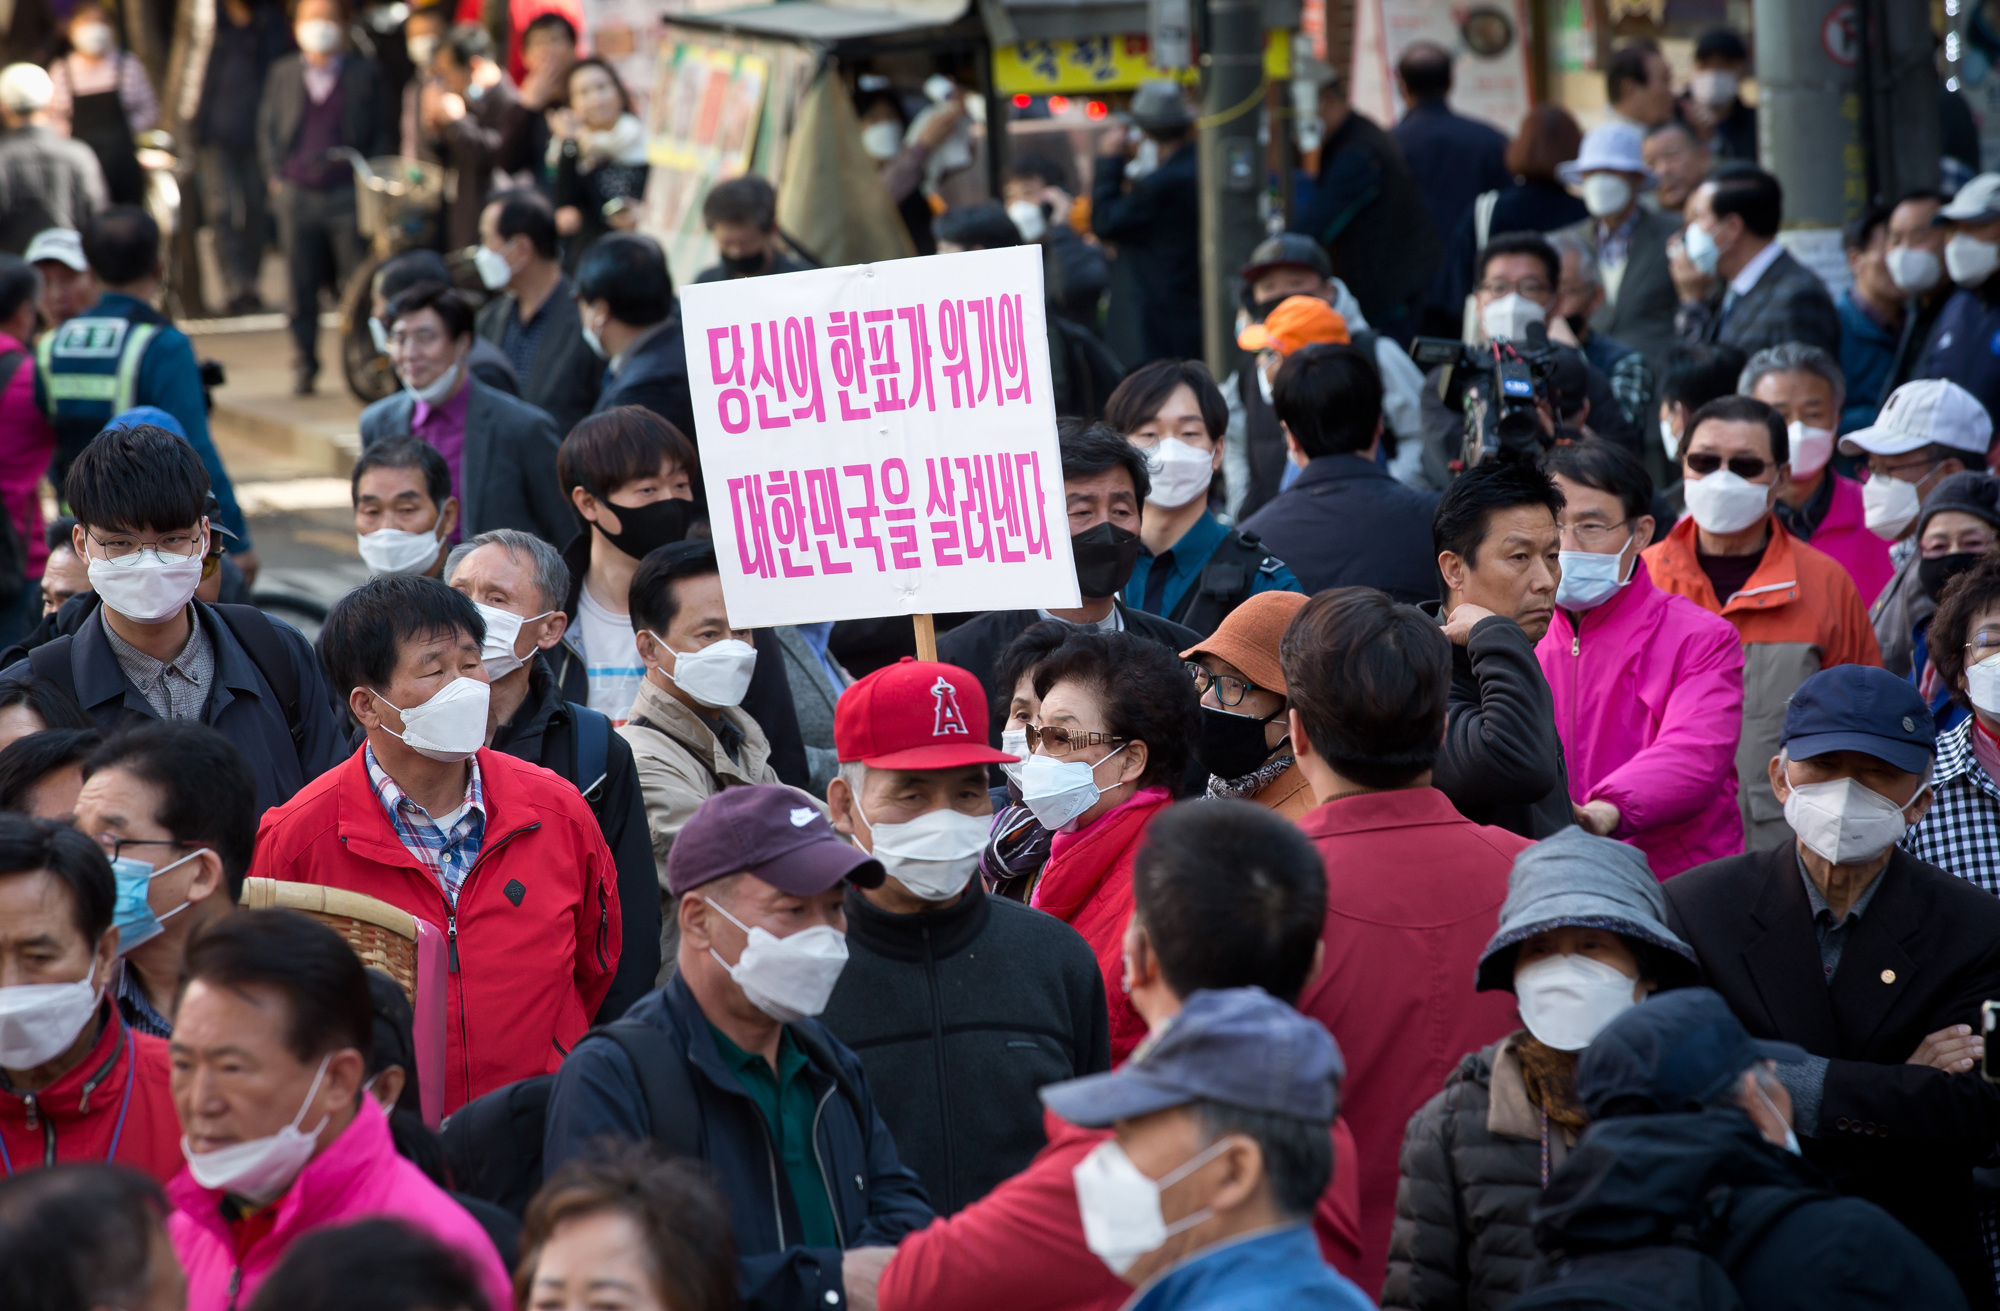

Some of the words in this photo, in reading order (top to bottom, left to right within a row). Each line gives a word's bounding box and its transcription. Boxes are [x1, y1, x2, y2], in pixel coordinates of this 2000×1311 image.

[707, 317, 826, 434] 당신의
[827, 304, 936, 421] 한표가
[939, 294, 1031, 408] 위기의
[727, 458, 921, 578] 대한민국을
[926, 451, 1052, 566] 살려낸다
[931, 676, 969, 736] A
